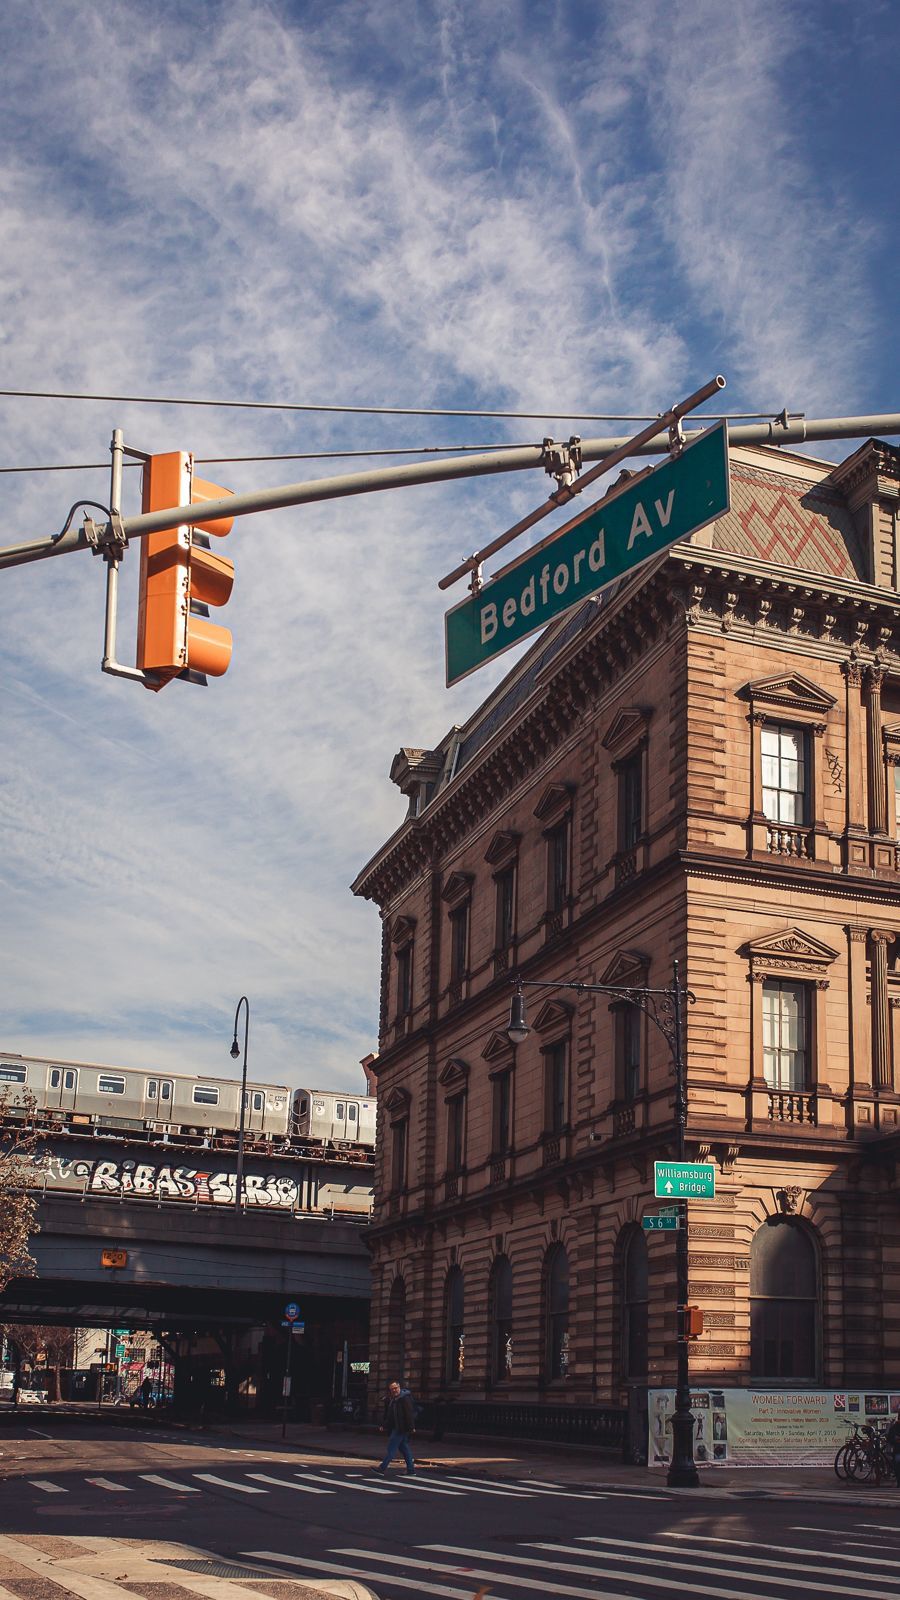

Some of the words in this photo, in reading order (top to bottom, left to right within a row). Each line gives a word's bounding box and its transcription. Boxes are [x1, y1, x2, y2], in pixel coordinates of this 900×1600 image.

[480, 528, 606, 645] Bedford
[627, 489, 675, 551] Av
[657, 1168, 712, 1182] Williamsburg
[679, 1182, 706, 1193] Bridge
[649, 1217, 654, 1228] S
[657, 1217, 663, 1228] 6
[751, 1395, 784, 1405] WOMEN
[786, 1395, 827, 1405] FORWARD
